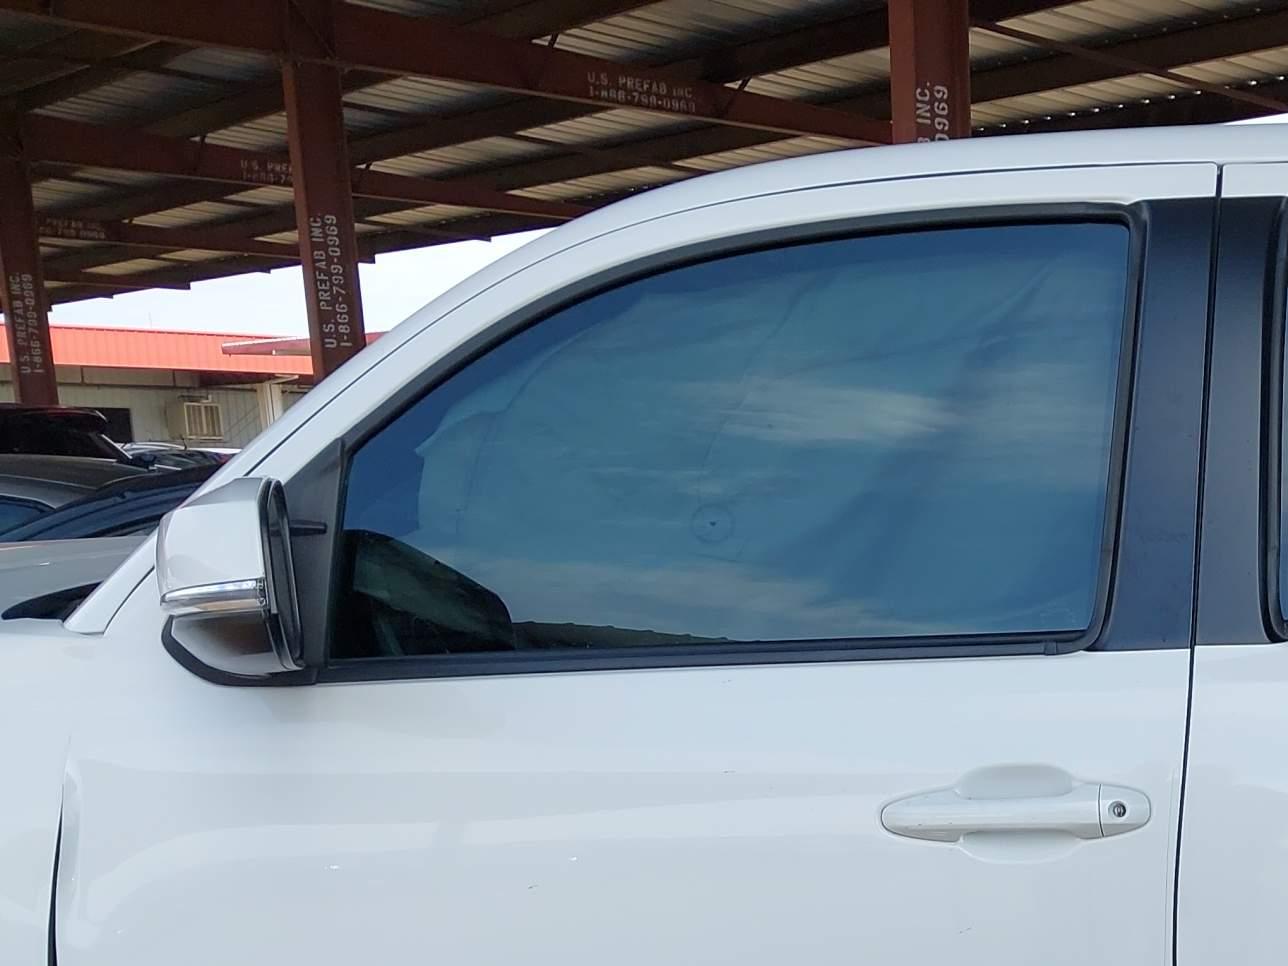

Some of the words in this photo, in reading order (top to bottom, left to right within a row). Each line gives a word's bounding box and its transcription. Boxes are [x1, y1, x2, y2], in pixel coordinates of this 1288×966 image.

[618, 75, 667, 95] PREFAB
[916, 82, 931, 125] INC.
[310, 213, 323, 242] INC.
[313, 250, 333, 310] PREFAB
[324, 214, 353, 347] 1-866-799-0969
[323, 319, 337, 348] U.S.
